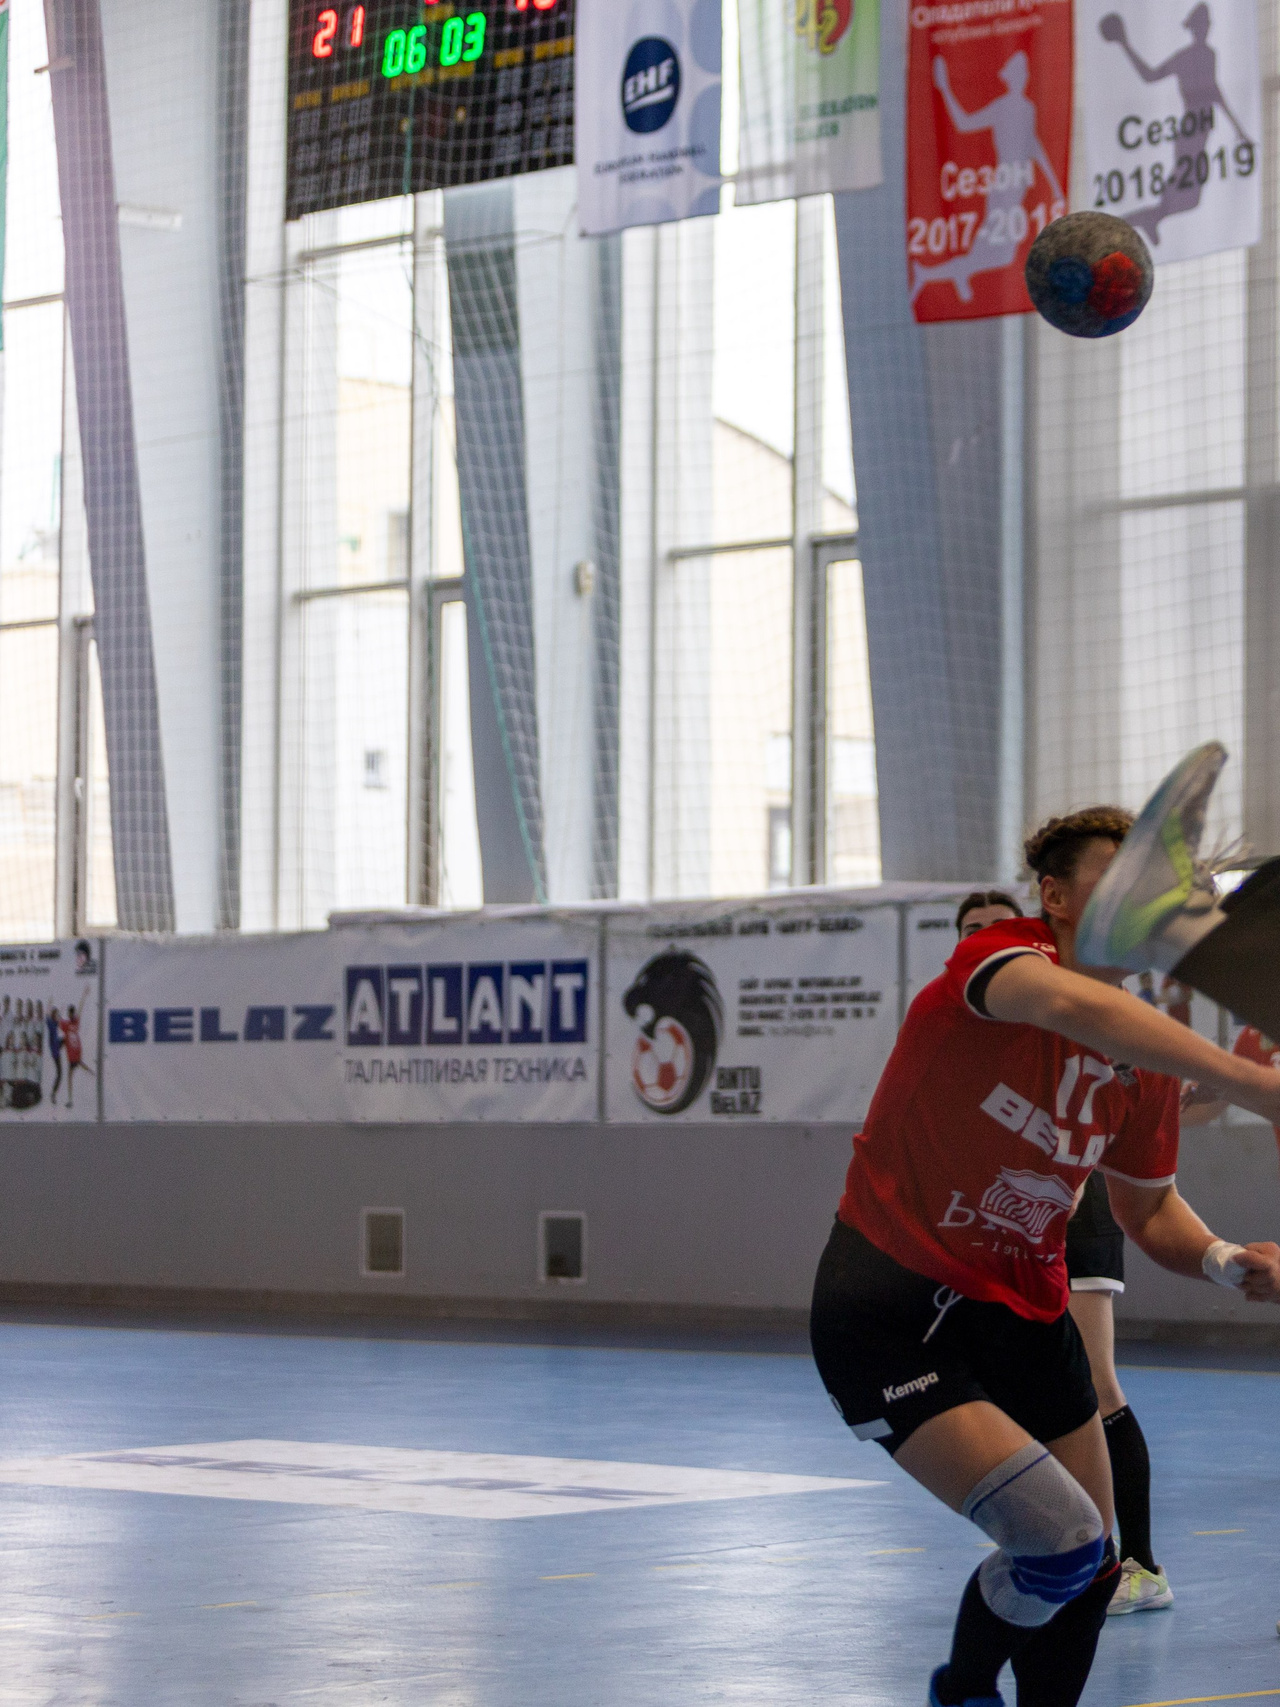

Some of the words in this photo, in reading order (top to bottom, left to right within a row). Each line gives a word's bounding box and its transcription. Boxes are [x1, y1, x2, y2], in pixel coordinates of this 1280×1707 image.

[313, 5, 365, 58] 21
[382, 24, 427, 78] 06
[440, 11, 487, 67] 03
[623, 58, 674, 103] EHF
[1117, 106, 1217, 151] Сезон
[940, 158, 1035, 201] Сезон
[1093, 141, 1256, 208] 2018-2019
[108, 1005, 335, 1043] BELAZ
[348, 968, 586, 1040] ATLANT
[344, 1057, 488, 1085] ТАЛАНТЛИВАЯ
[493, 1056, 588, 1083] ТЕХНИКА
[1056, 1053, 1115, 1125] 17
[979, 1081, 1116, 1168] BELA
[882, 1371, 939, 1402] Kempa
